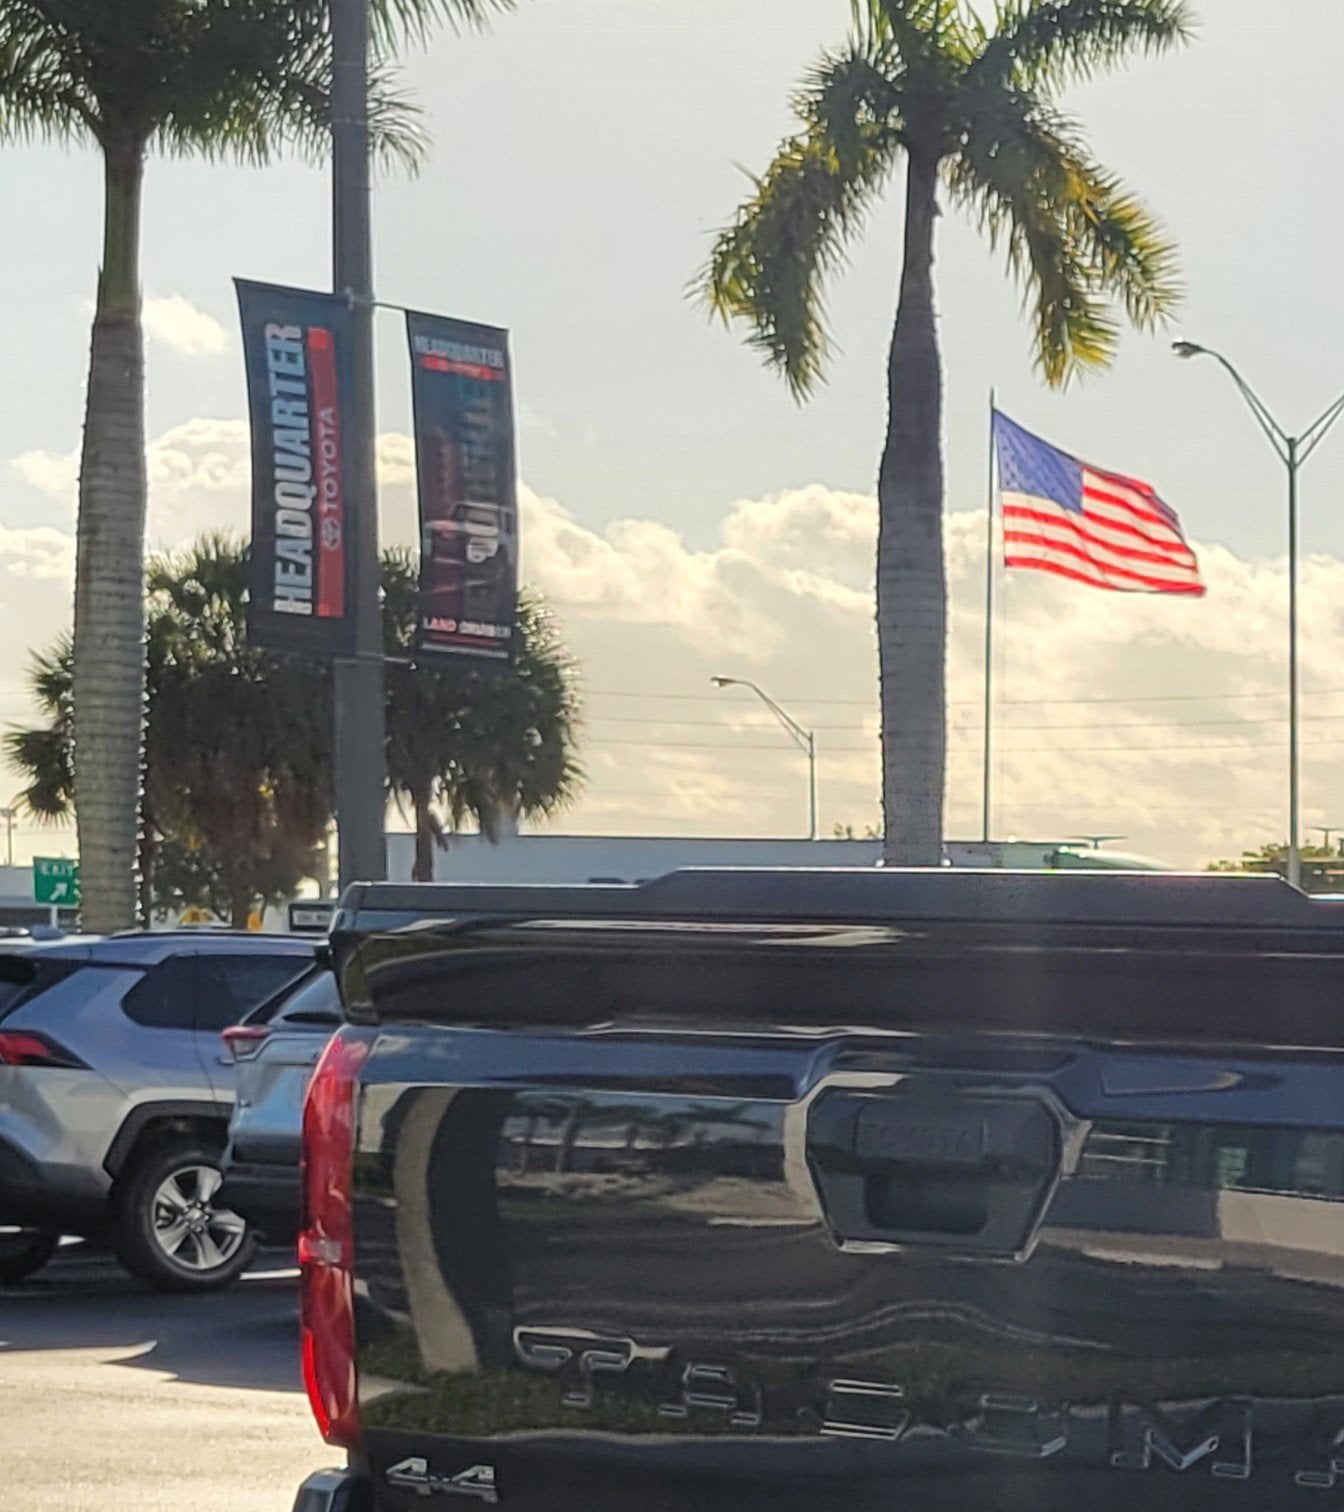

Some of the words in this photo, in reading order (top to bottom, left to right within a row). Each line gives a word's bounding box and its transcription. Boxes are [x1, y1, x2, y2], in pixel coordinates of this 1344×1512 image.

[265, 324, 317, 615] HEADQUARTER
[319, 407, 339, 511] TOYOTA
[423, 617, 457, 632] LAND
